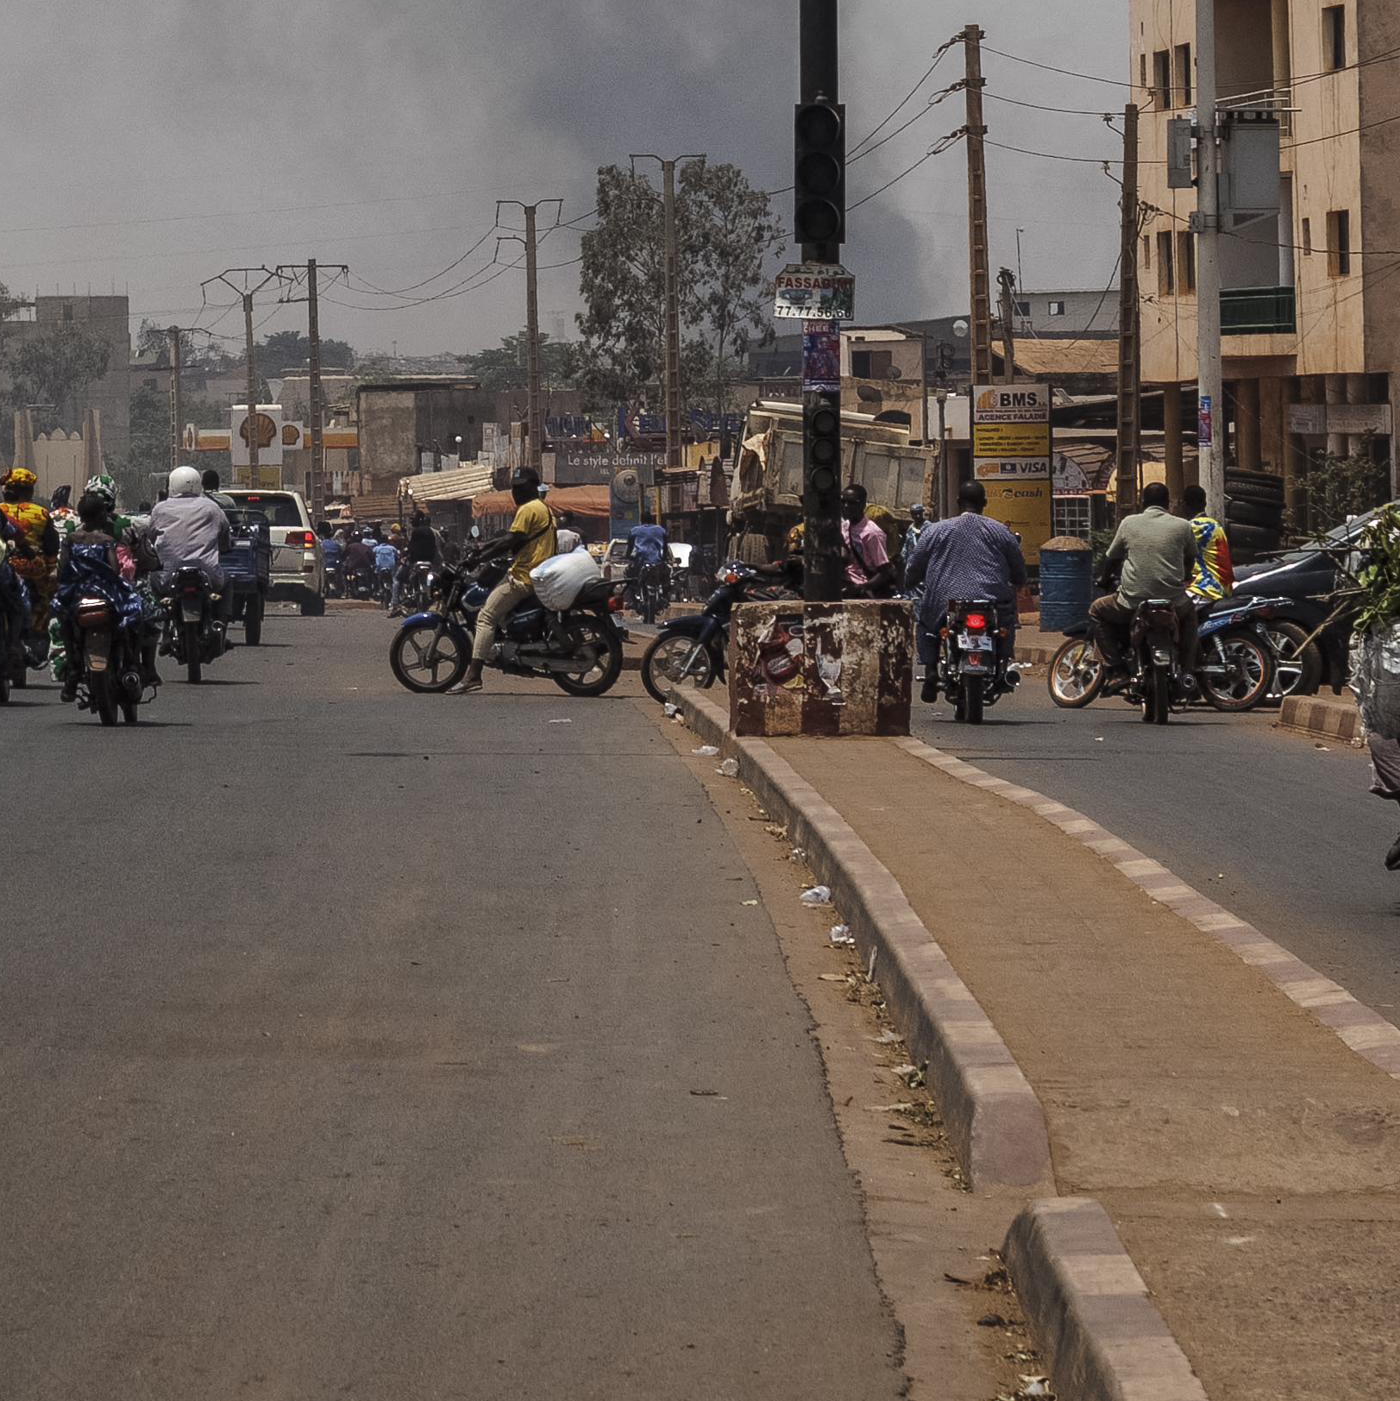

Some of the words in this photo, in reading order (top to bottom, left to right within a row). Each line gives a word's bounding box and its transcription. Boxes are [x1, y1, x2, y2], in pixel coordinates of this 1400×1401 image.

[1000, 392, 1038, 407] BMS
[568, 453, 580, 465] Le
[583, 453, 609, 468] style
[1019, 462, 1047, 474] VISA
[1014, 488, 1043, 498] cash
